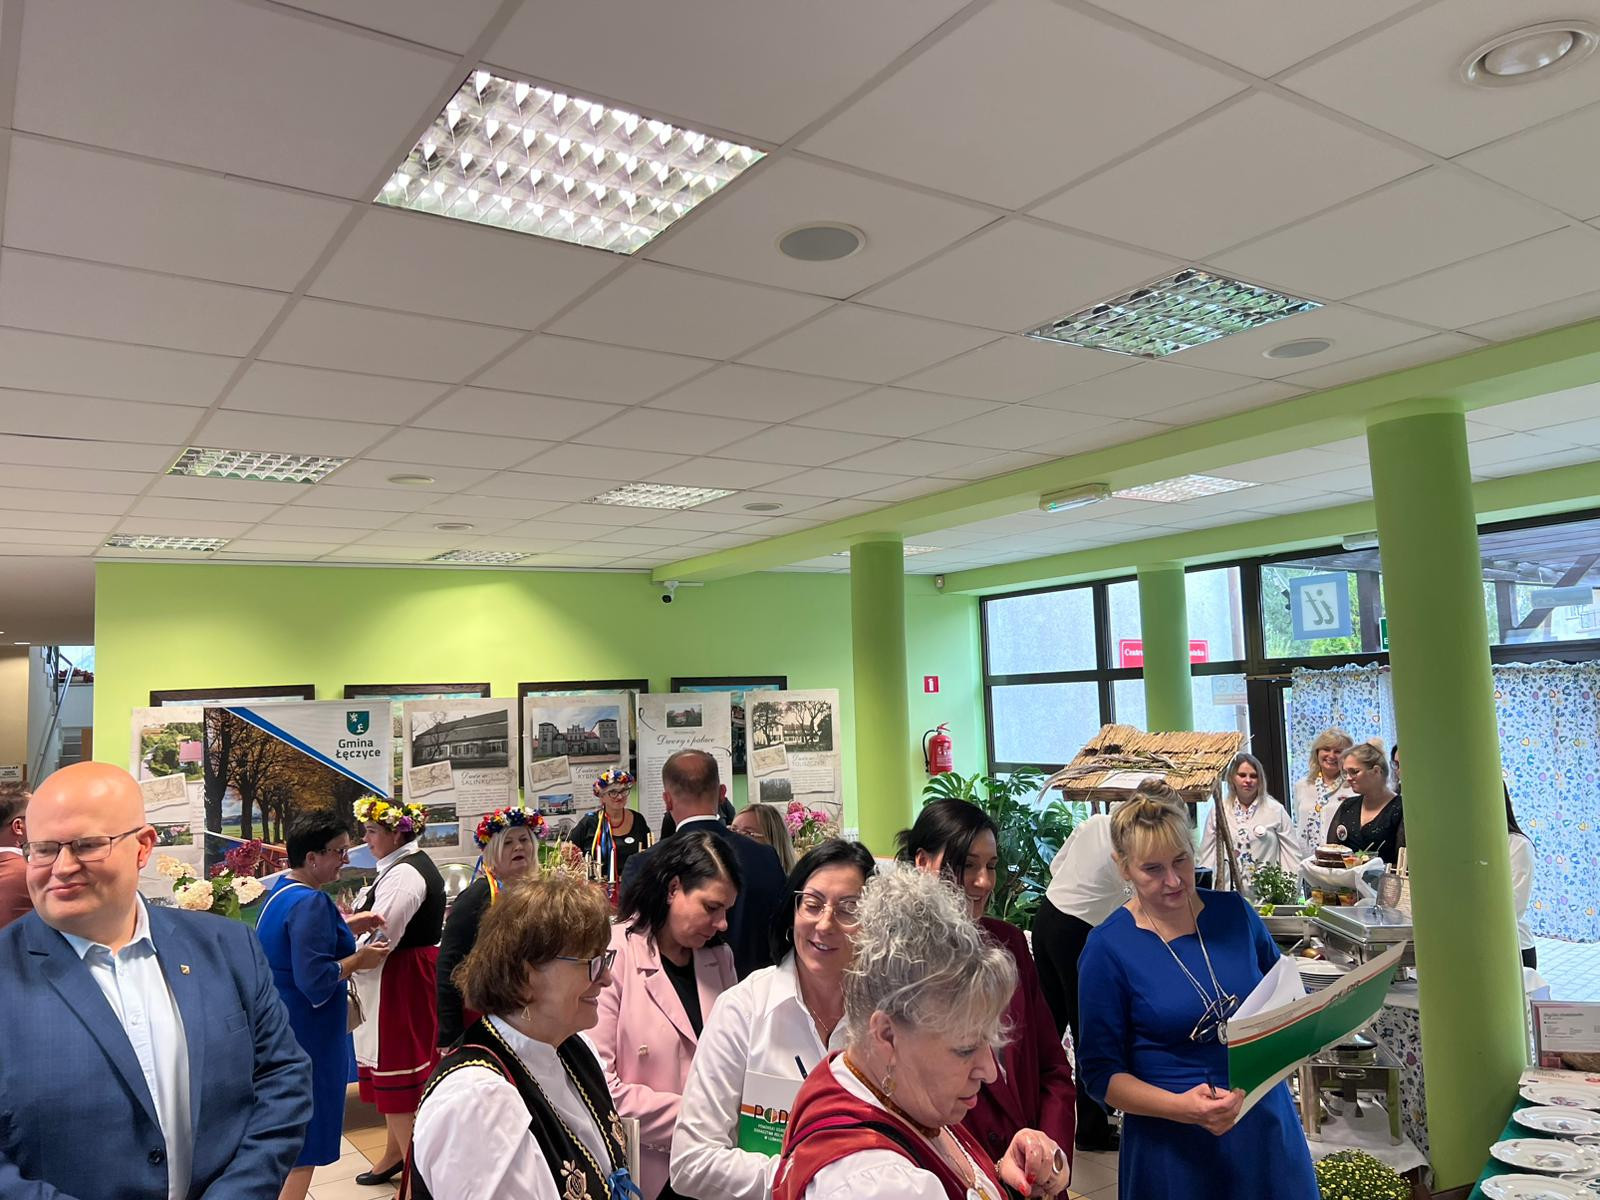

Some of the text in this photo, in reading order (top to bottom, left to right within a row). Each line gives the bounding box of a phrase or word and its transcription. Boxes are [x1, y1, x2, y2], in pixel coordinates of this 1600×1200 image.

[338, 738, 374, 749] Gmina
[657, 734, 684, 747] Dwory
[335, 749, 381, 761] Łęczyce
[754, 1104, 790, 1125] POD
